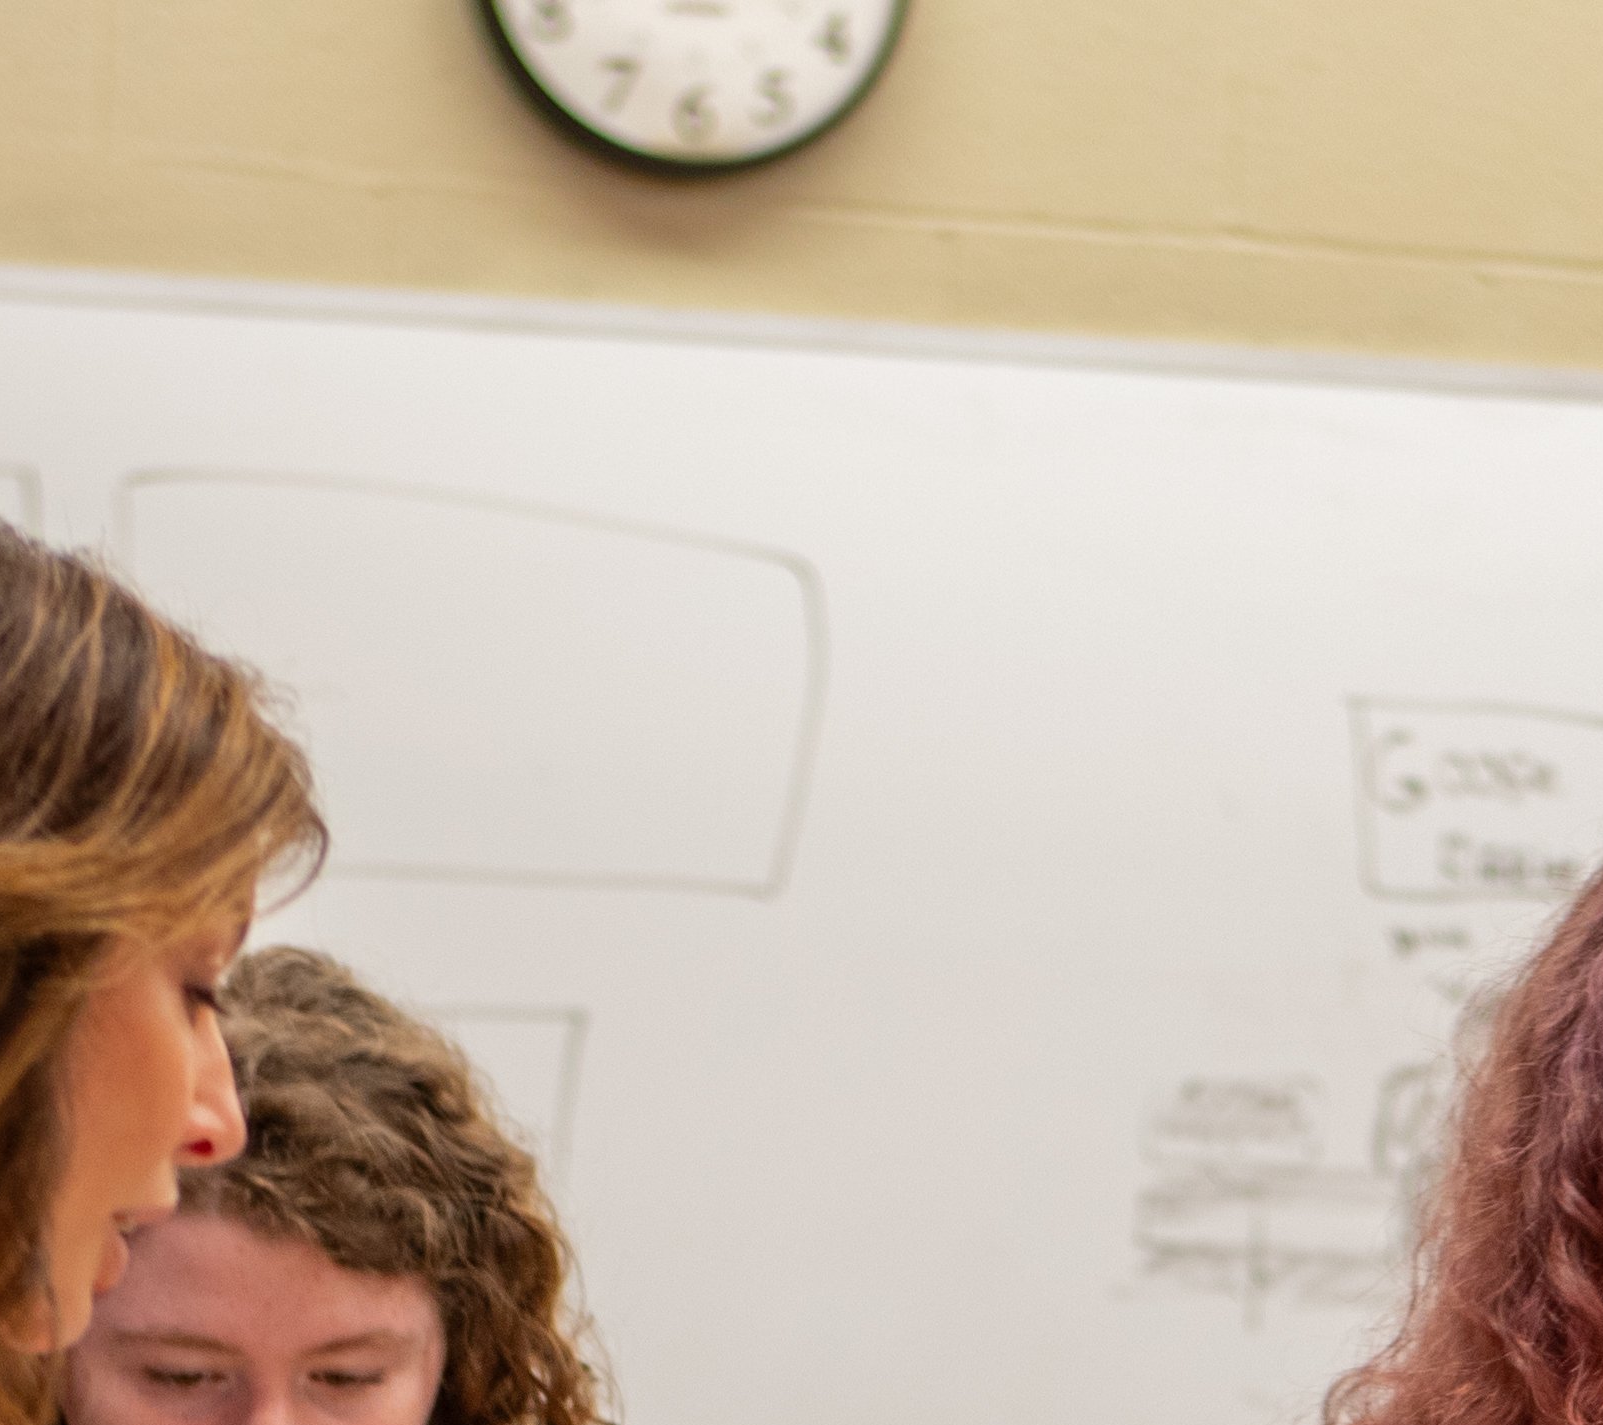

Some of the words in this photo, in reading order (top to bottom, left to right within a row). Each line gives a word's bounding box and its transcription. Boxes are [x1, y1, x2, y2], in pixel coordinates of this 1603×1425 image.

[814, 10, 853, 65] 4
[600, 55, 640, 114] 7
[747, 67, 797, 129] 5
[669, 84, 721, 146] 6
